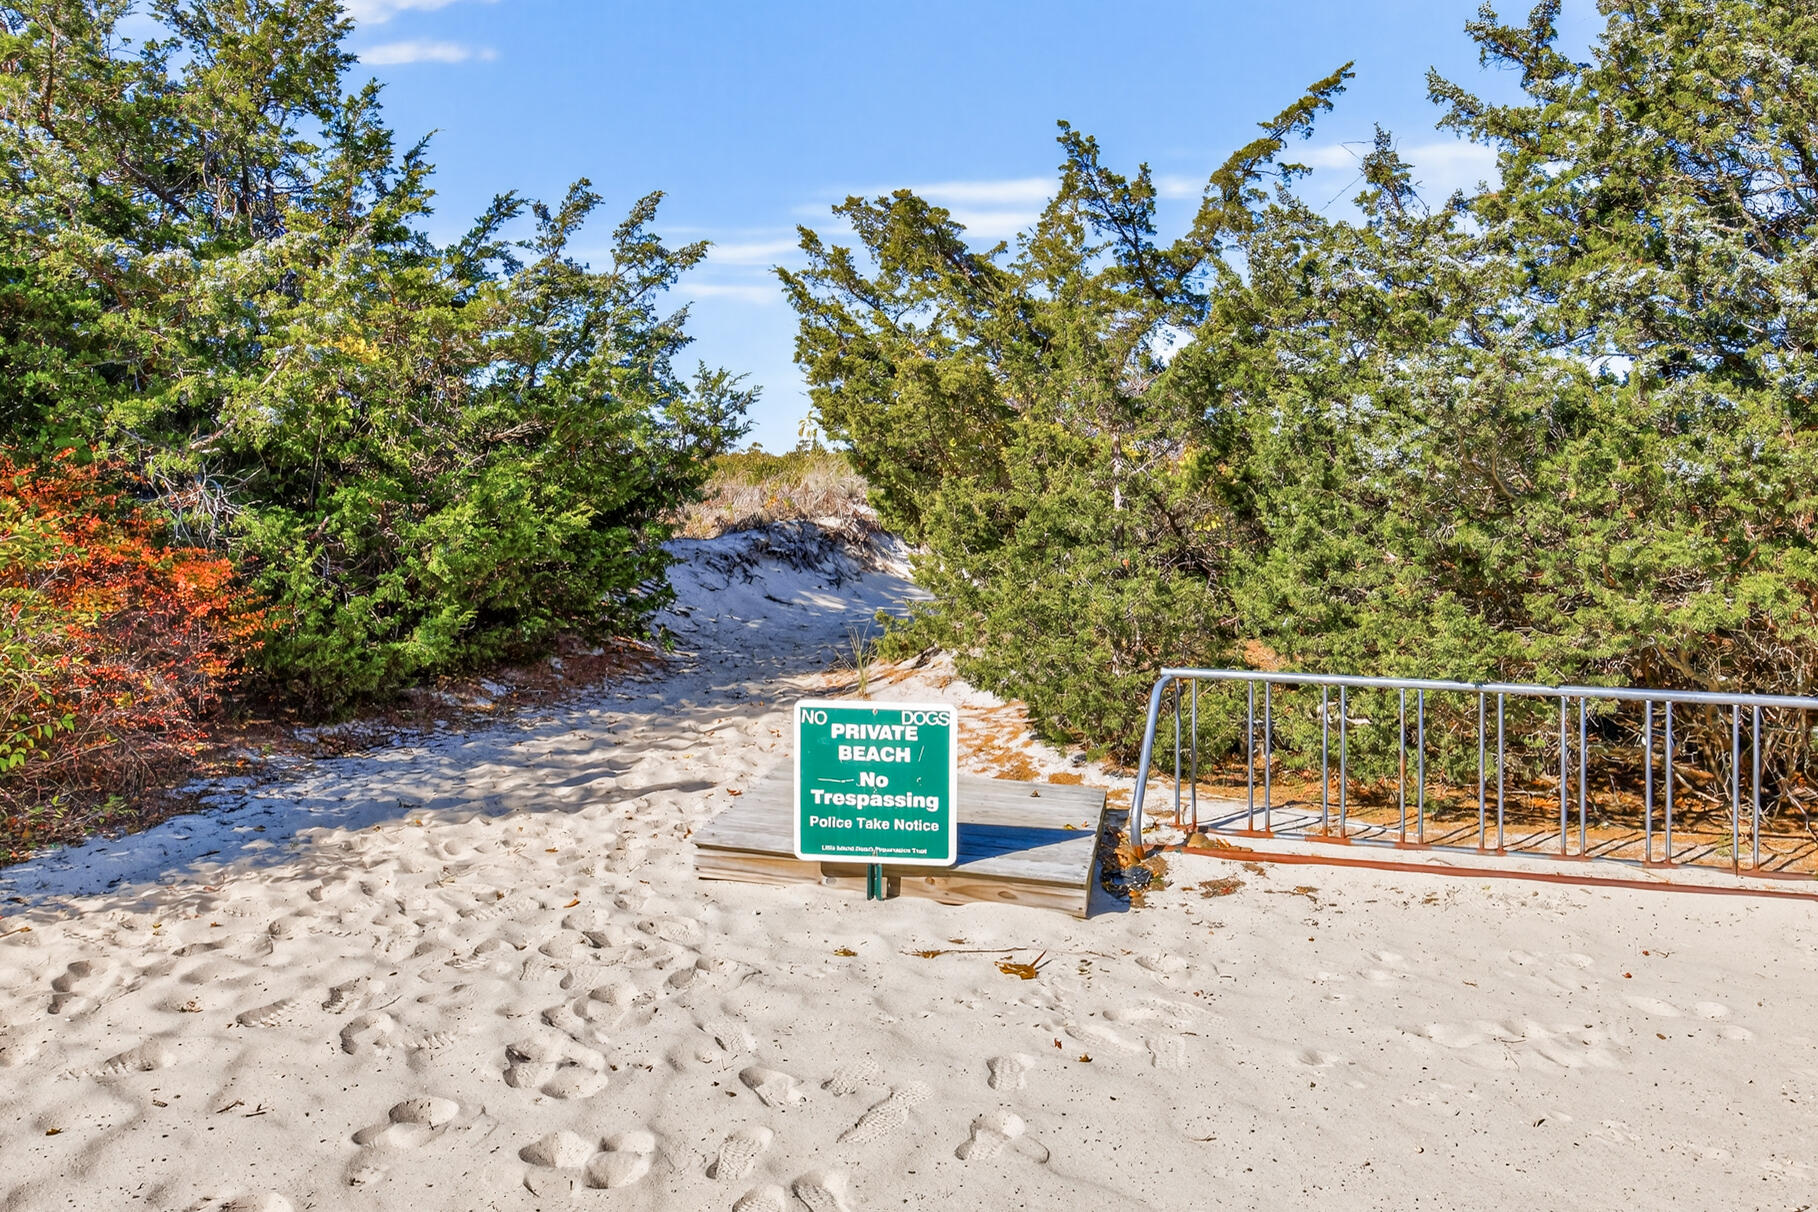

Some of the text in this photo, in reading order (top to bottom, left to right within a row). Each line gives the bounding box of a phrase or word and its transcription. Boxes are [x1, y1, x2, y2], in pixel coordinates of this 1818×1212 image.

[801, 709, 950, 726] NO DOGS
[831, 723, 919, 741] PRIVATE
[838, 745, 911, 762] BEACH
[859, 772, 889, 788] No
[811, 789, 940, 812] Trespassing
[810, 816, 940, 832] Police Take Notice
